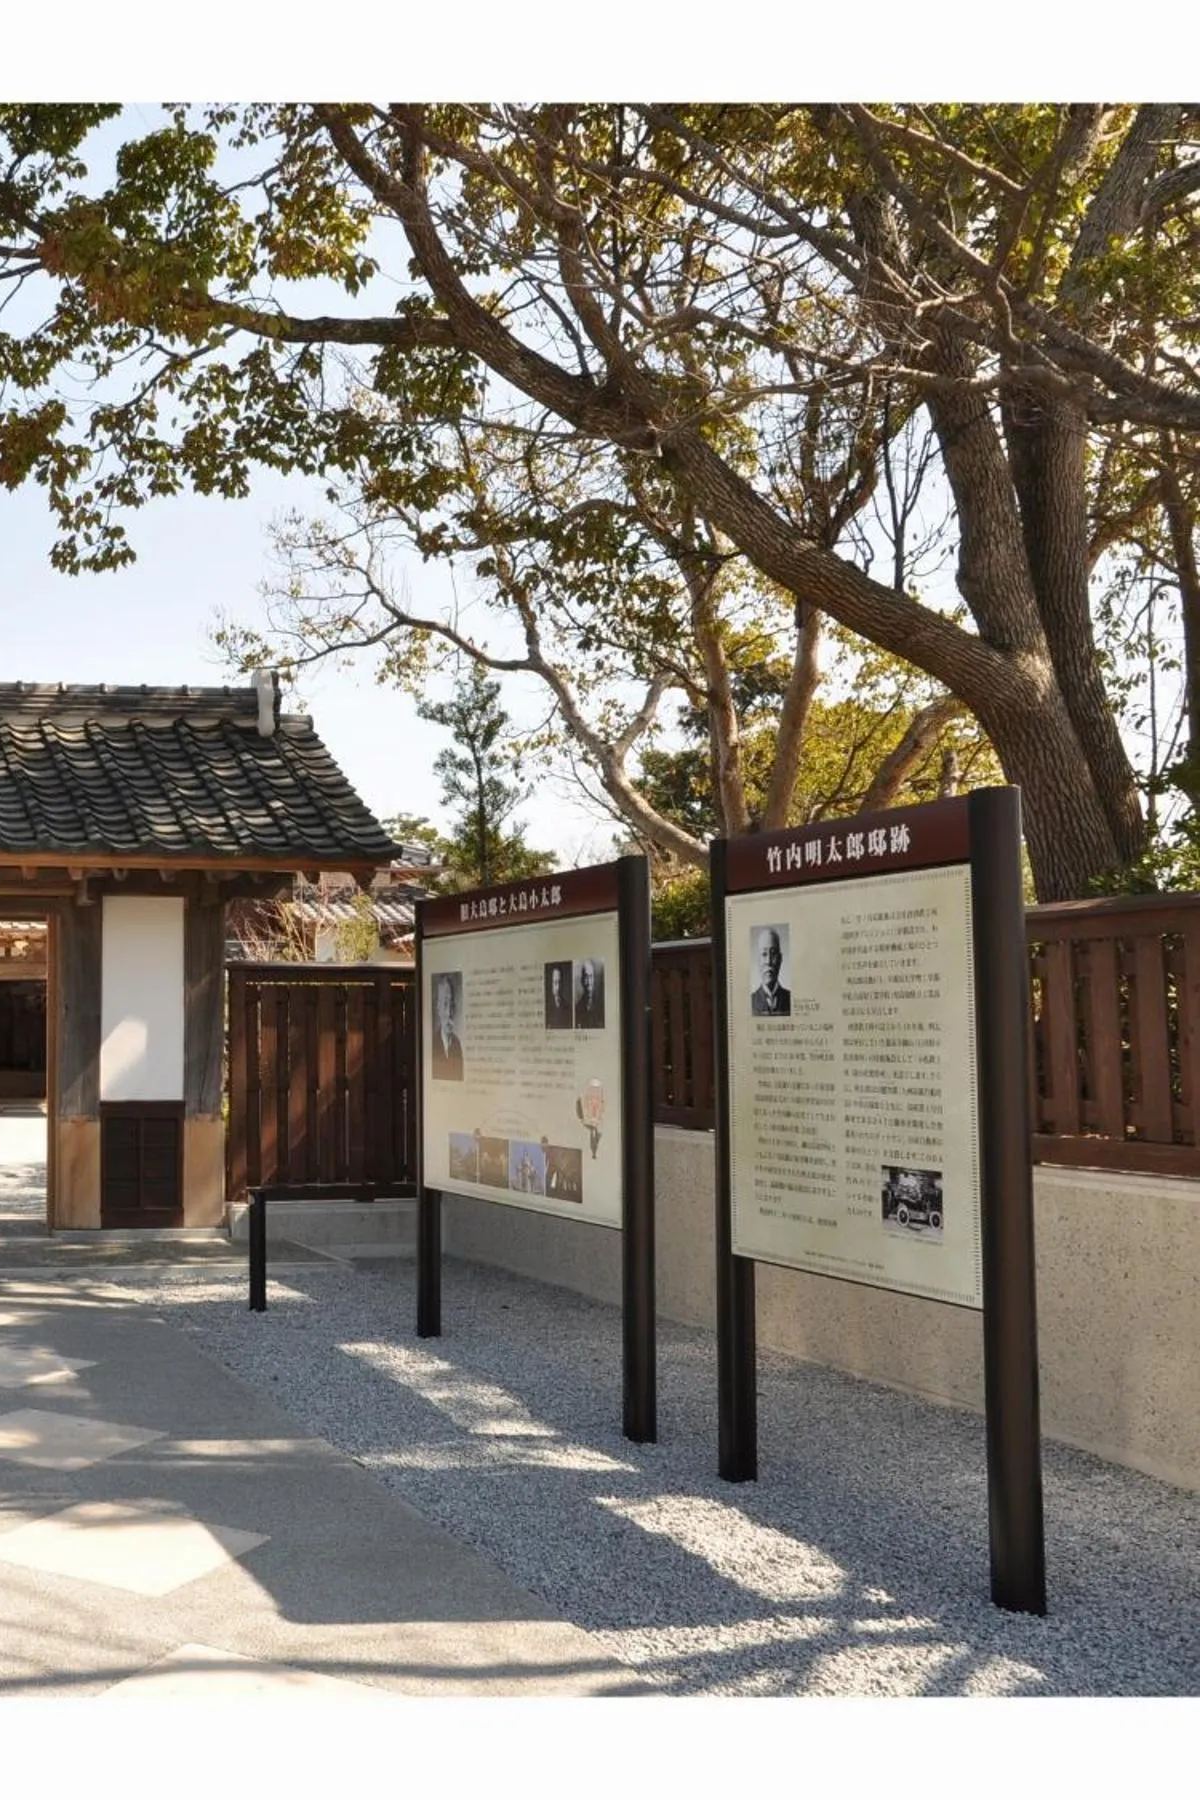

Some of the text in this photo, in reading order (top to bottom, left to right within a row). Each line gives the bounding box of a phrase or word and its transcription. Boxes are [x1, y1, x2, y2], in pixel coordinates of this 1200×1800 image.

[767, 824, 910, 873] 竹内明太郎邸跡
